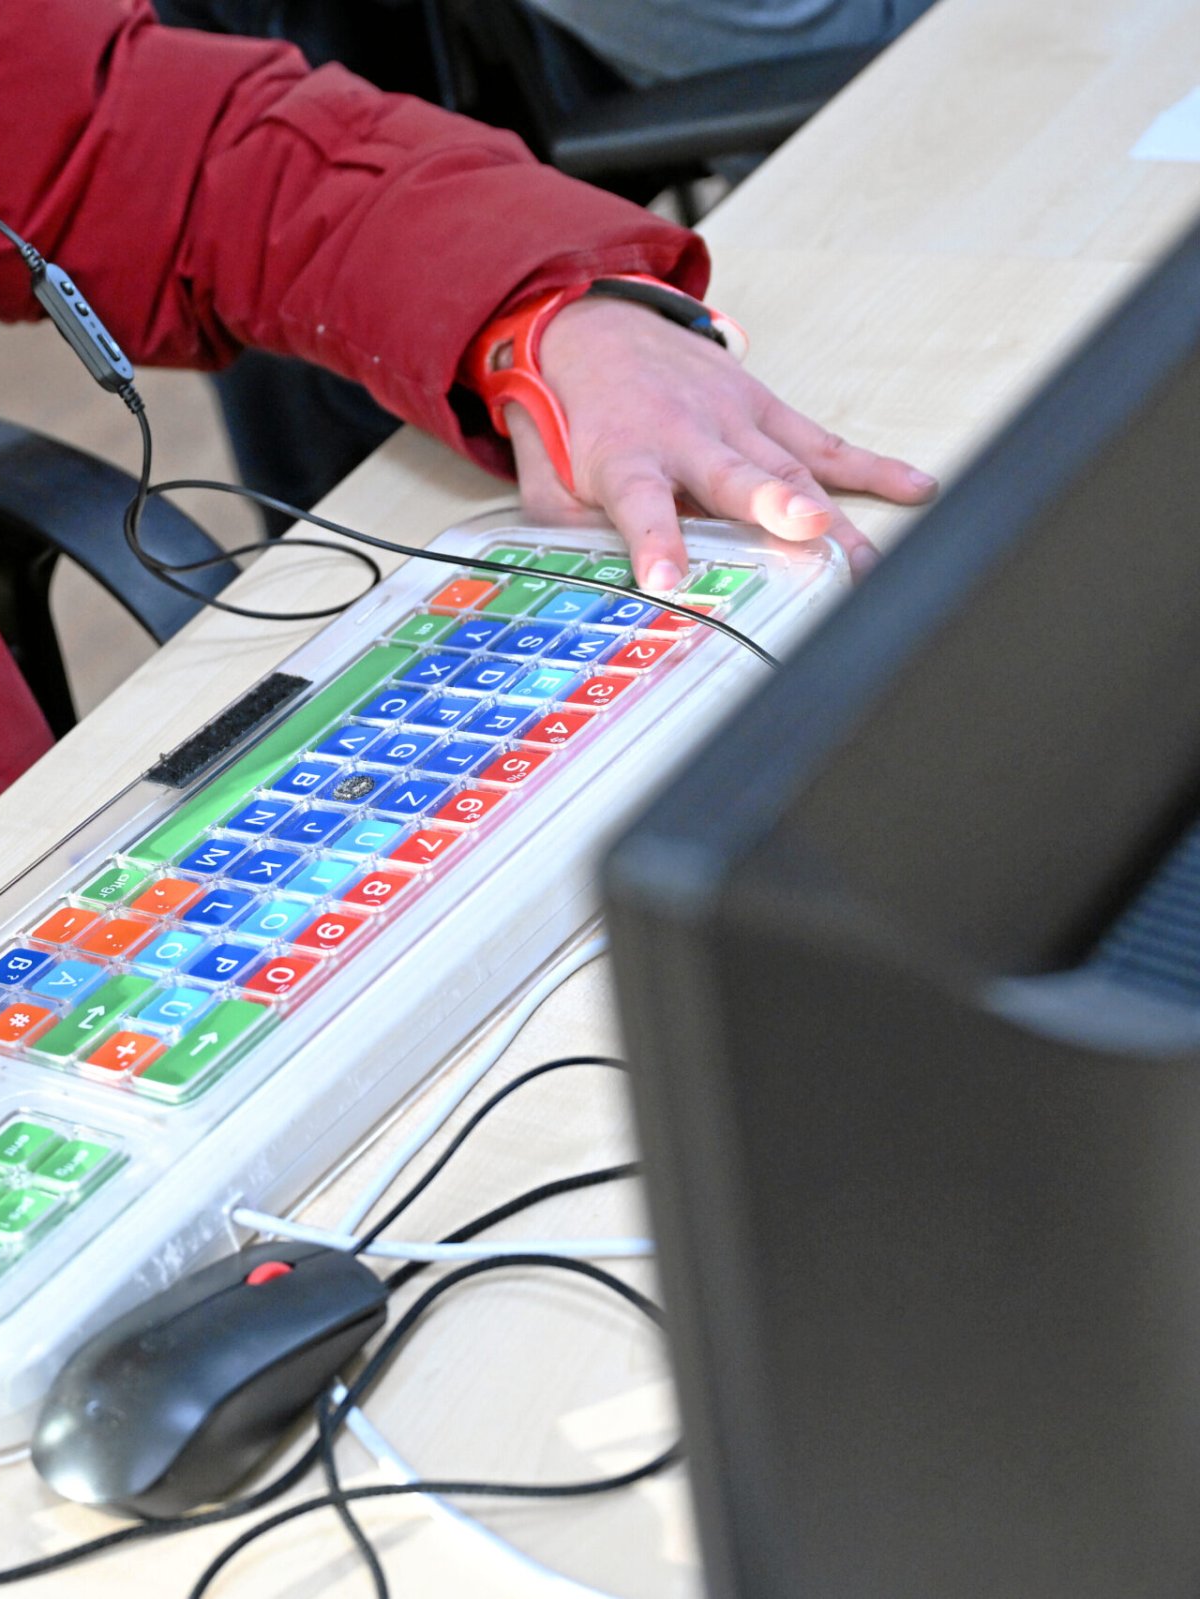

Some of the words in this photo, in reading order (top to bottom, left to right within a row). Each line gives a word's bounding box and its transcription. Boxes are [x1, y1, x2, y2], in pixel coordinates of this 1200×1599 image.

[554, 601, 581, 614] A
[612, 602, 644, 618] Q
[465, 630, 492, 642] Y
[517, 635, 544, 649] S
[569, 640, 605, 658] W
[626, 646, 656, 659] 2
[419, 663, 451, 677] X
[477, 669, 506, 684] D
[531, 675, 562, 689] E
[586, 683, 614, 697] 3
[380, 698, 407, 713] C
[439, 709, 461, 721] F
[485, 715, 516, 729] R
[544, 721, 569, 735] 4
[338, 736, 366, 749] V
[386, 743, 417, 758] G
[446, 754, 474, 767] T
[502, 758, 531, 772] 5
[292, 772, 321, 787] B
[395, 791, 428, 806] Z
[456, 798, 484, 812] 6
[244, 810, 277, 826] N
[303, 822, 323, 833] J
[355, 832, 385, 846] U
[417, 838, 443, 852] 7
[195, 848, 231, 867] M
[249, 861, 282, 876] K
[362, 880, 392, 896] 8
[202, 902, 233, 913] L
[260, 913, 289, 930] O
[316, 922, 345, 939] 9
[155, 942, 188, 959] Ö
[216, 956, 239, 973] P
[48, 971, 84, 987] Ä
[159, 1001, 192, 1016] Ü
[9, 1013, 30, 1028] #
